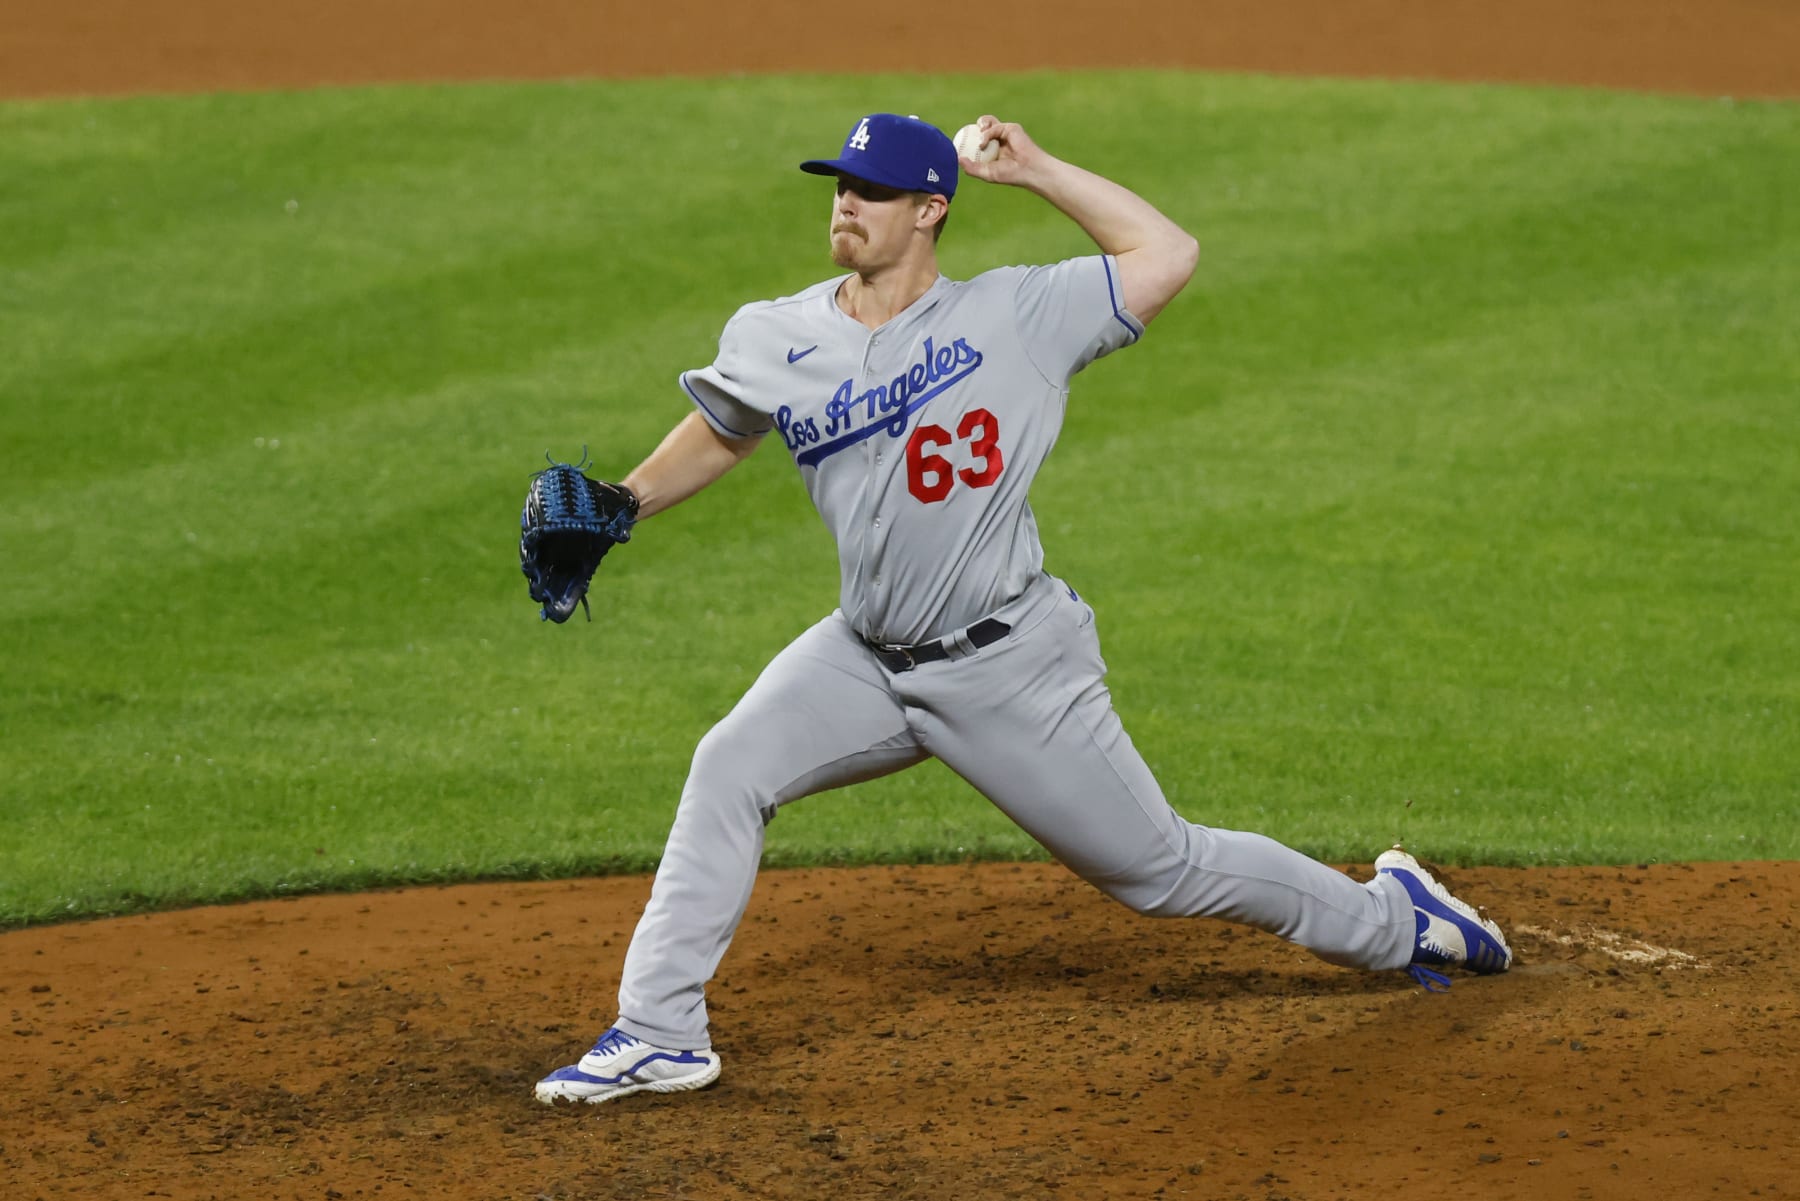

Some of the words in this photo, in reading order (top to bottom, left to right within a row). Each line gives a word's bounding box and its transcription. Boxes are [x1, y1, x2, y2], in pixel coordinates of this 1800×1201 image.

[849, 118, 871, 151] LA
[771, 405, 820, 449] Los
[825, 336, 982, 438] Angeles
[906, 408, 1004, 504] 63
